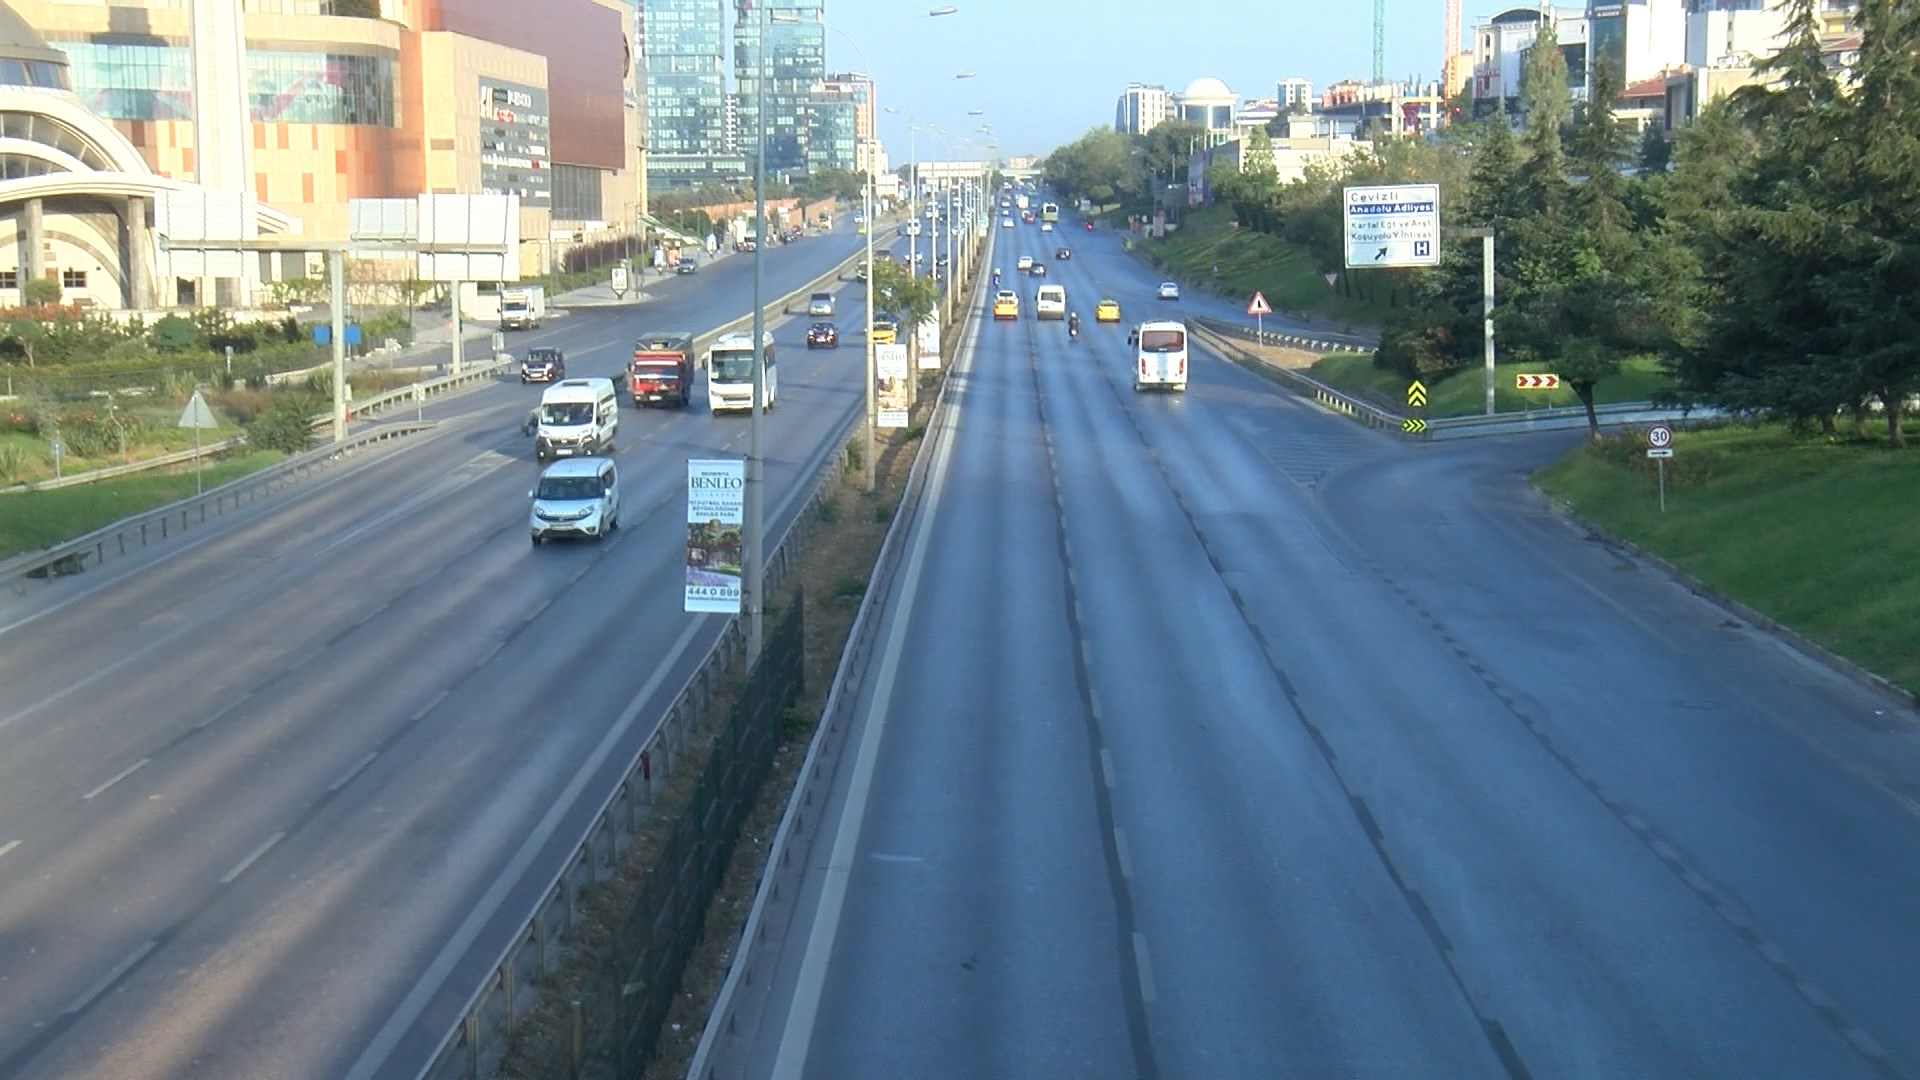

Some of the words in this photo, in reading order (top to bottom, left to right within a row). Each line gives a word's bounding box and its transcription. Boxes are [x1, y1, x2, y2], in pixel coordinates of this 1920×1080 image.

[1351, 192, 1398, 202] Cevizli
[1350, 204, 1392, 213] Anadolu
[1393, 202, 1434, 213] Adliyesi
[1351, 221, 1379, 229] Kartal
[1416, 241, 1428, 255] H
[1653, 431, 1667, 441] 30
[691, 477, 742, 489] BENLEO
[688, 587, 707, 596] 444
